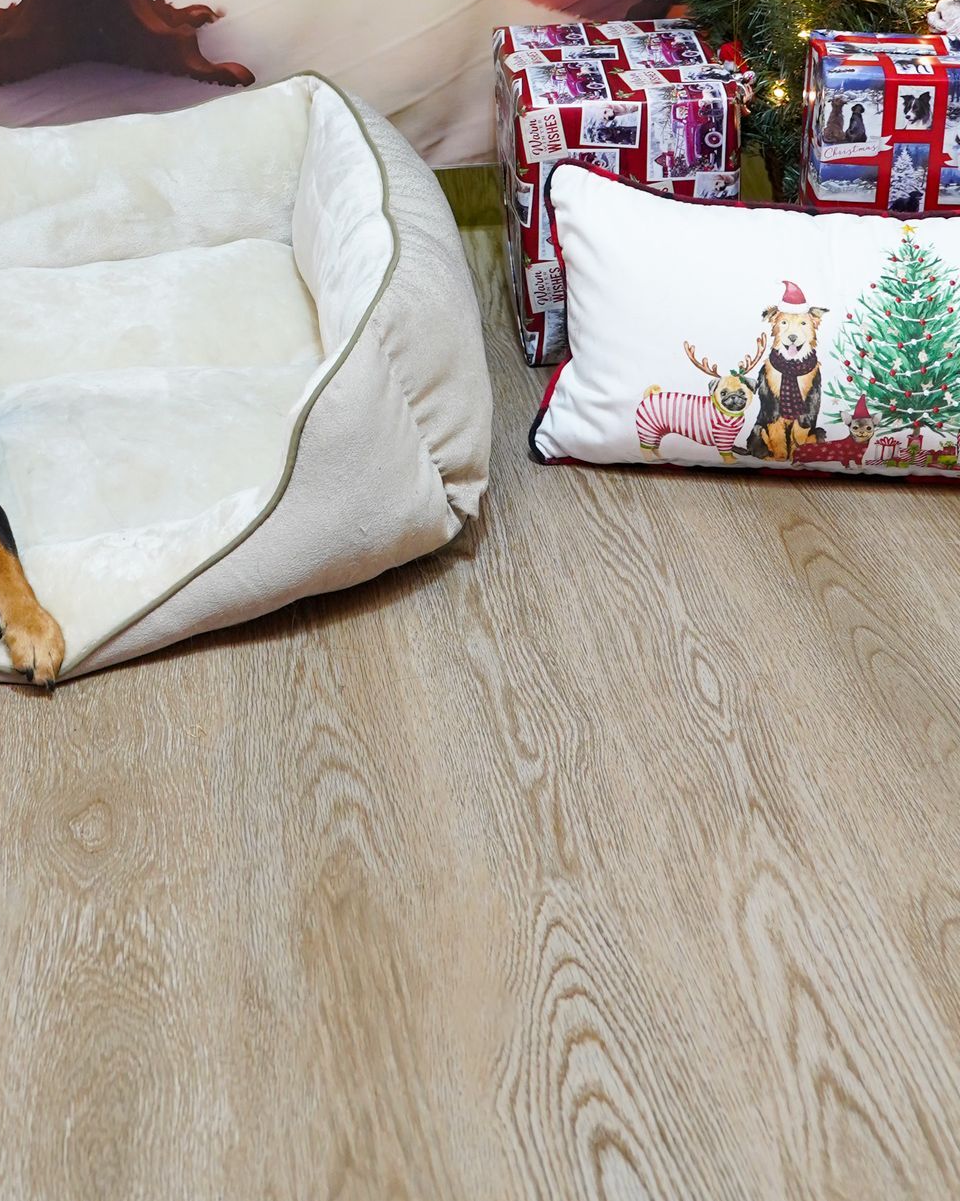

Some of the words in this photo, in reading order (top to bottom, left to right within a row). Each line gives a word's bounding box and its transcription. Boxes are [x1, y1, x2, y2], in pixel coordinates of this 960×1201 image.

[529, 119, 543, 156] Warm
[544, 114, 562, 154] WISHES
[823, 143, 877, 159] Christmas
[533, 270, 549, 306] Warm
[549, 266, 566, 304] WISHES
